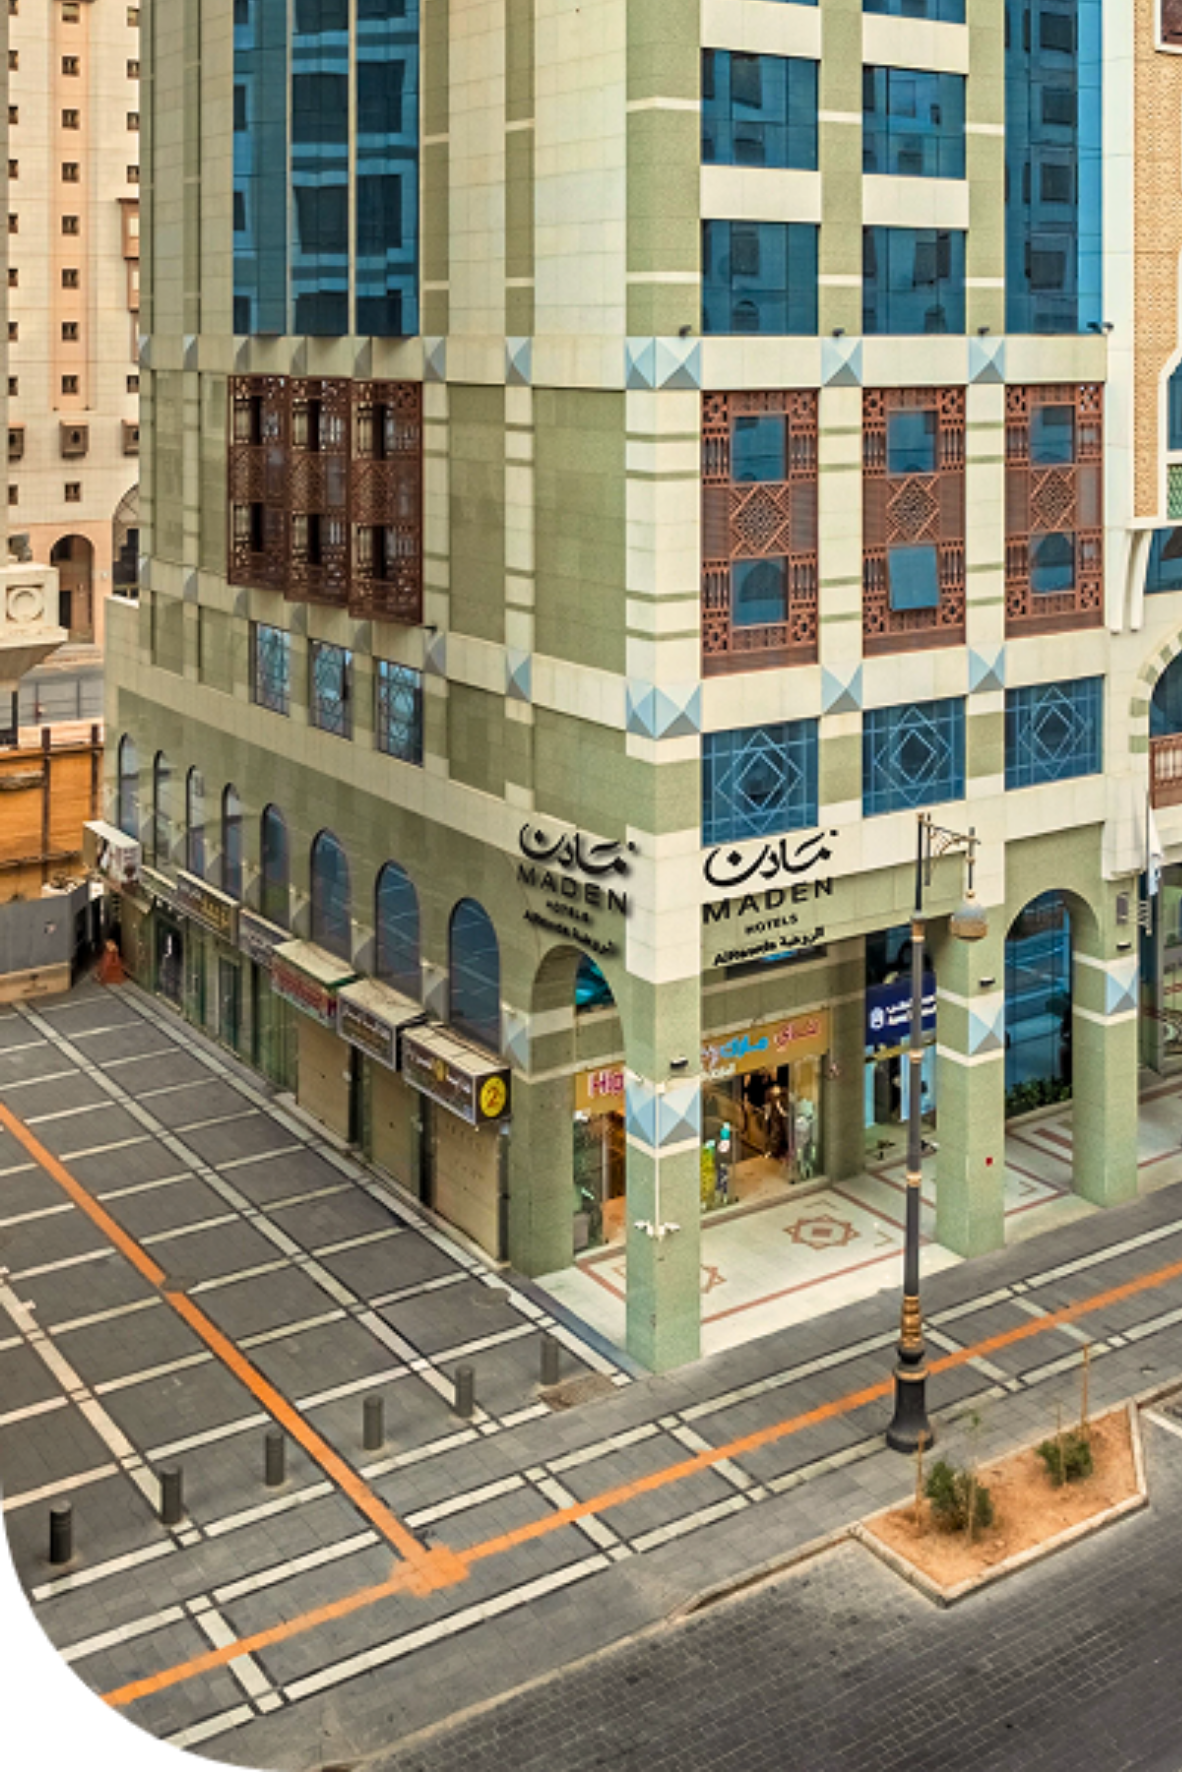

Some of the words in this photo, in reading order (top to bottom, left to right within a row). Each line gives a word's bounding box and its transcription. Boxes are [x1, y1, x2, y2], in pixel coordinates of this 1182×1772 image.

[517, 863, 627, 916] MADEN
[702, 877, 834, 925] MADEN
[744, 913, 799, 936] HOTELS
